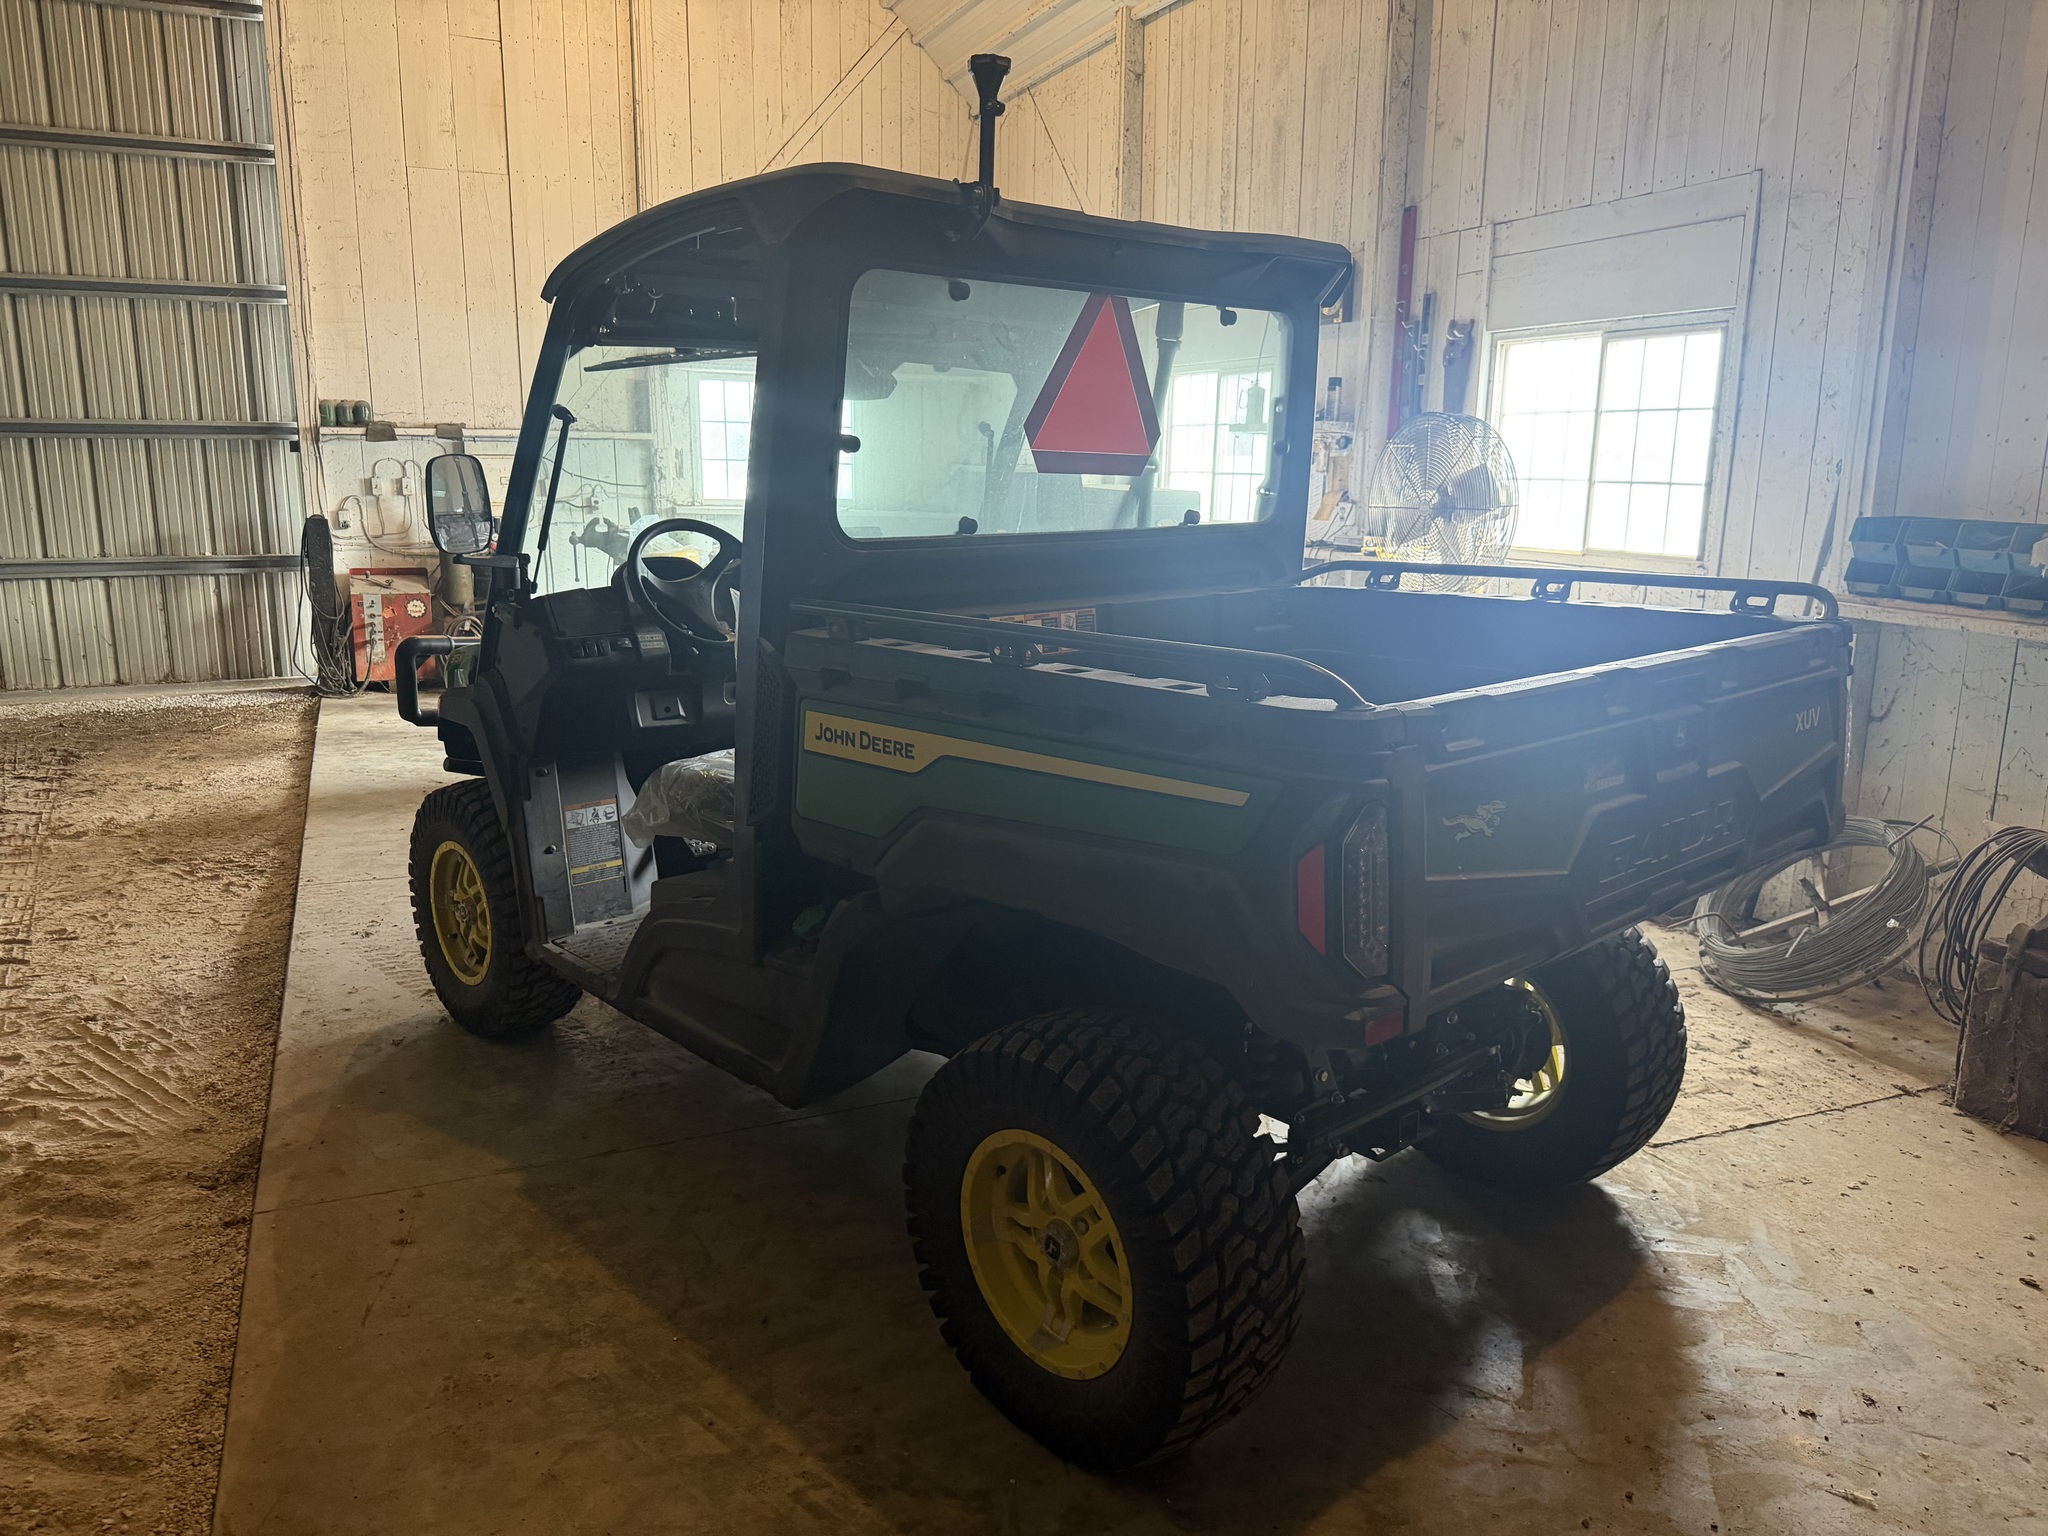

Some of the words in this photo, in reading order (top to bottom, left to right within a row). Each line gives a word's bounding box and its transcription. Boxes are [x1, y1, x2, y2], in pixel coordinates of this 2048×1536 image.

[1795, 705, 1821, 733] XUV
[815, 722, 856, 748] JOHN
[859, 730, 915, 760] DEERE
